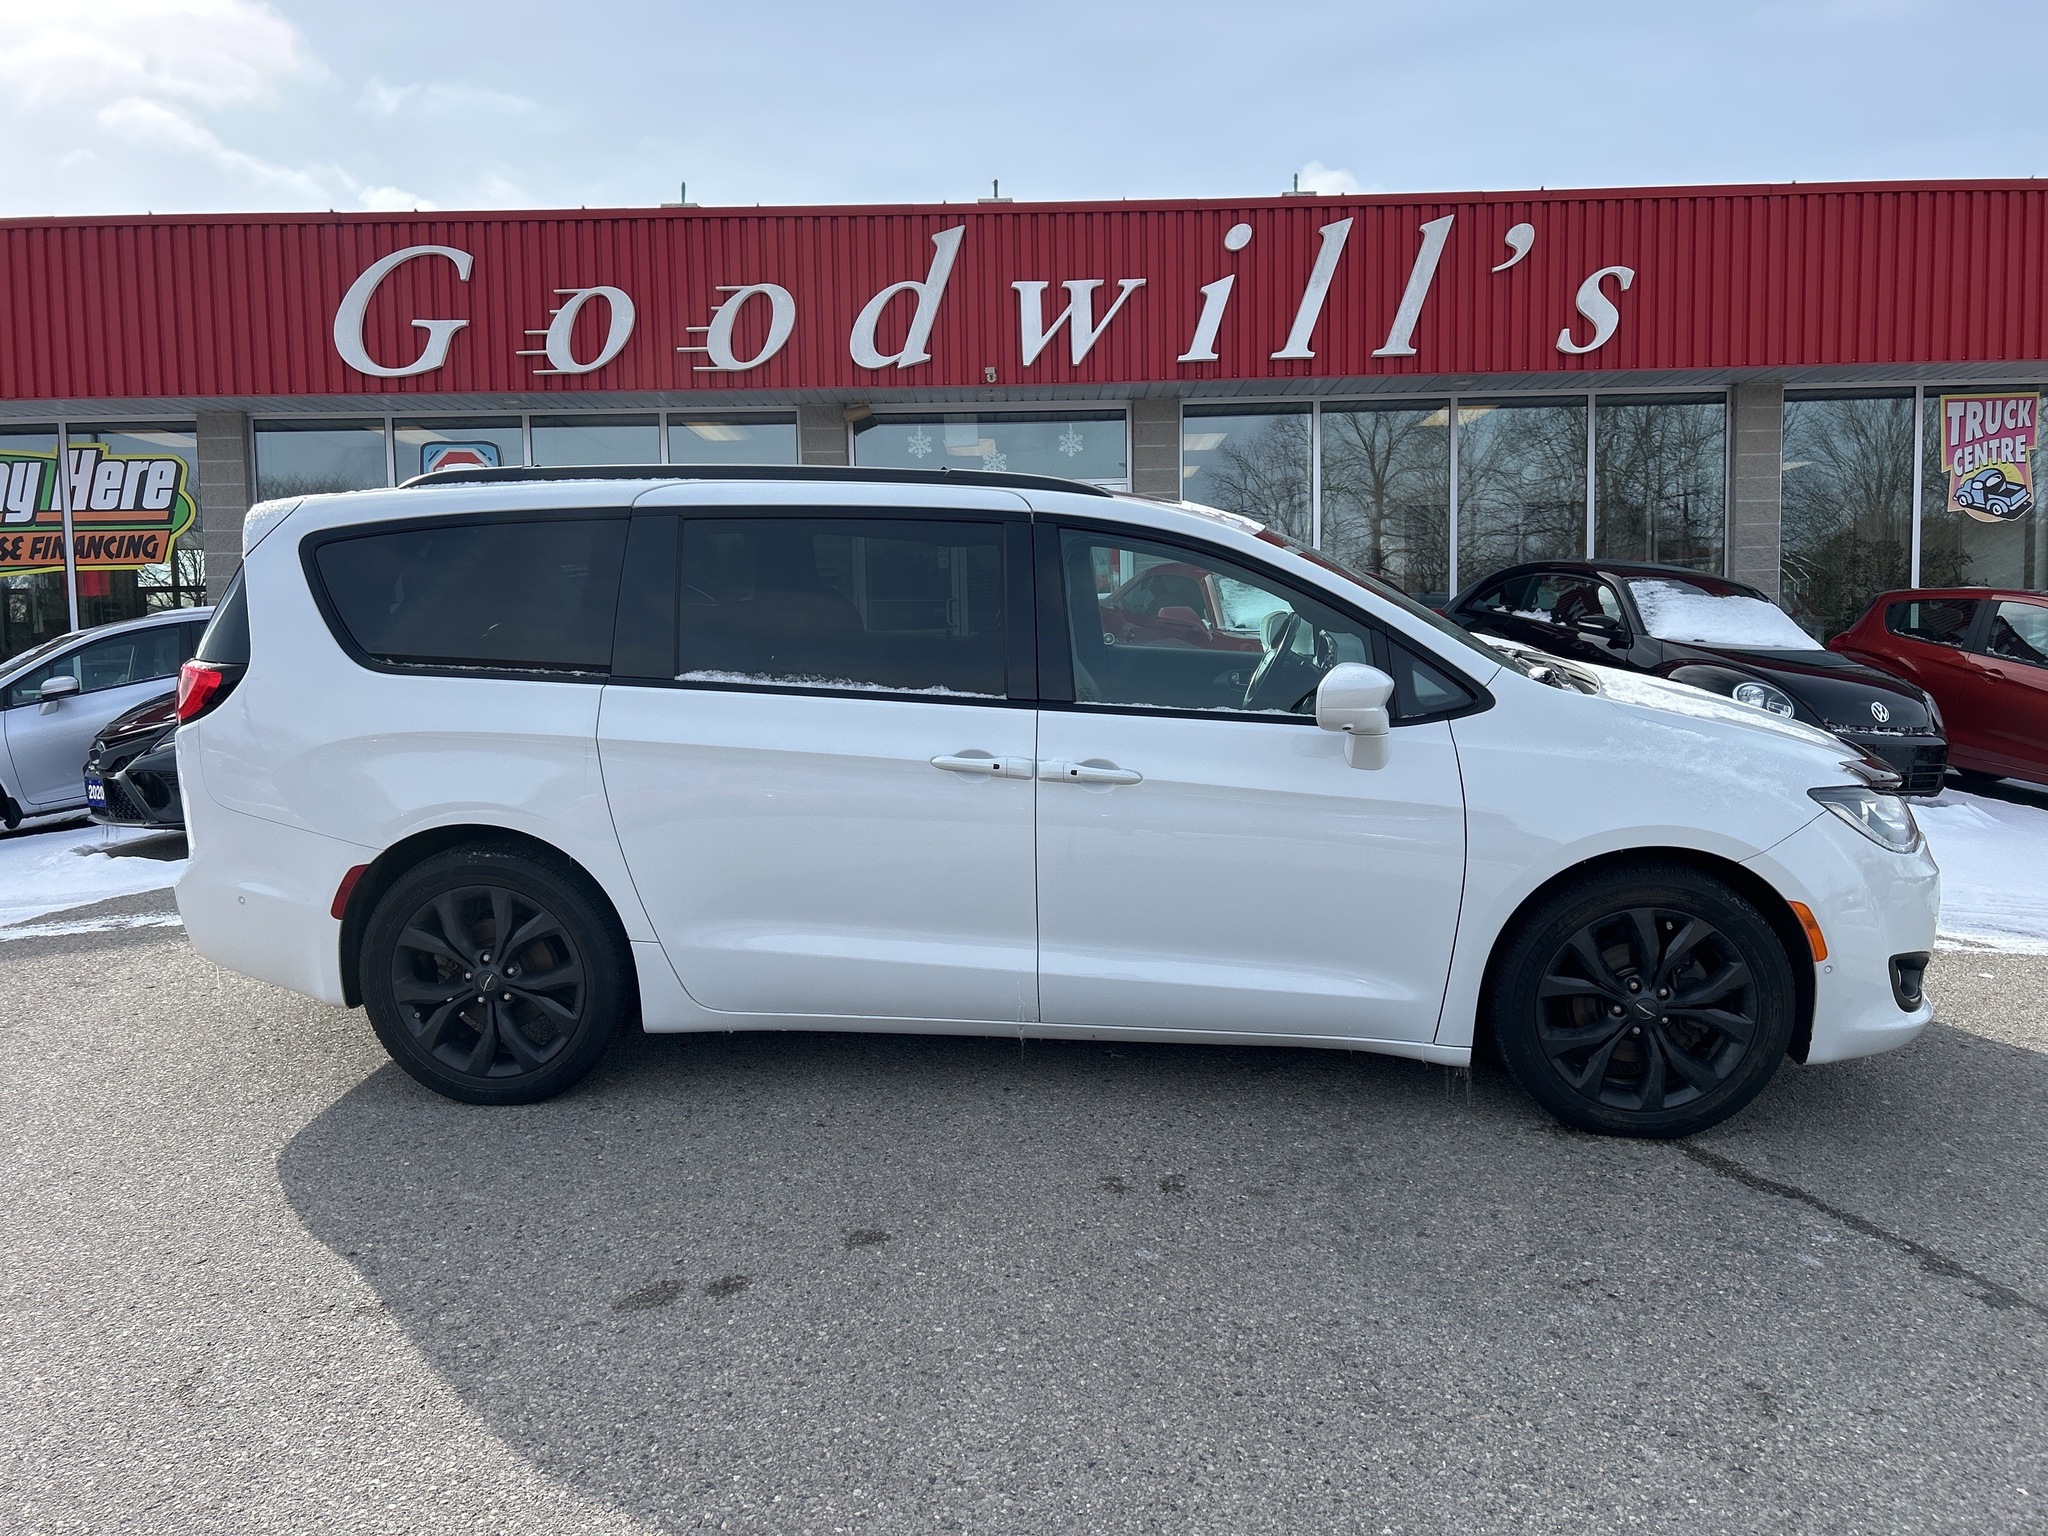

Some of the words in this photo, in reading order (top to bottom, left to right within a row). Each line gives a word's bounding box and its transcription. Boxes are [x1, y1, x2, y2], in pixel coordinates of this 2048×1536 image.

[333, 213, 1635, 378] Goodwill's
[1947, 399, 2033, 447] TRUCK
[1953, 434, 2027, 477] CENTRE
[51, 449, 178, 511] Here
[29, 534, 160, 561] FINANCING
[88, 784, 105, 800] 2020
